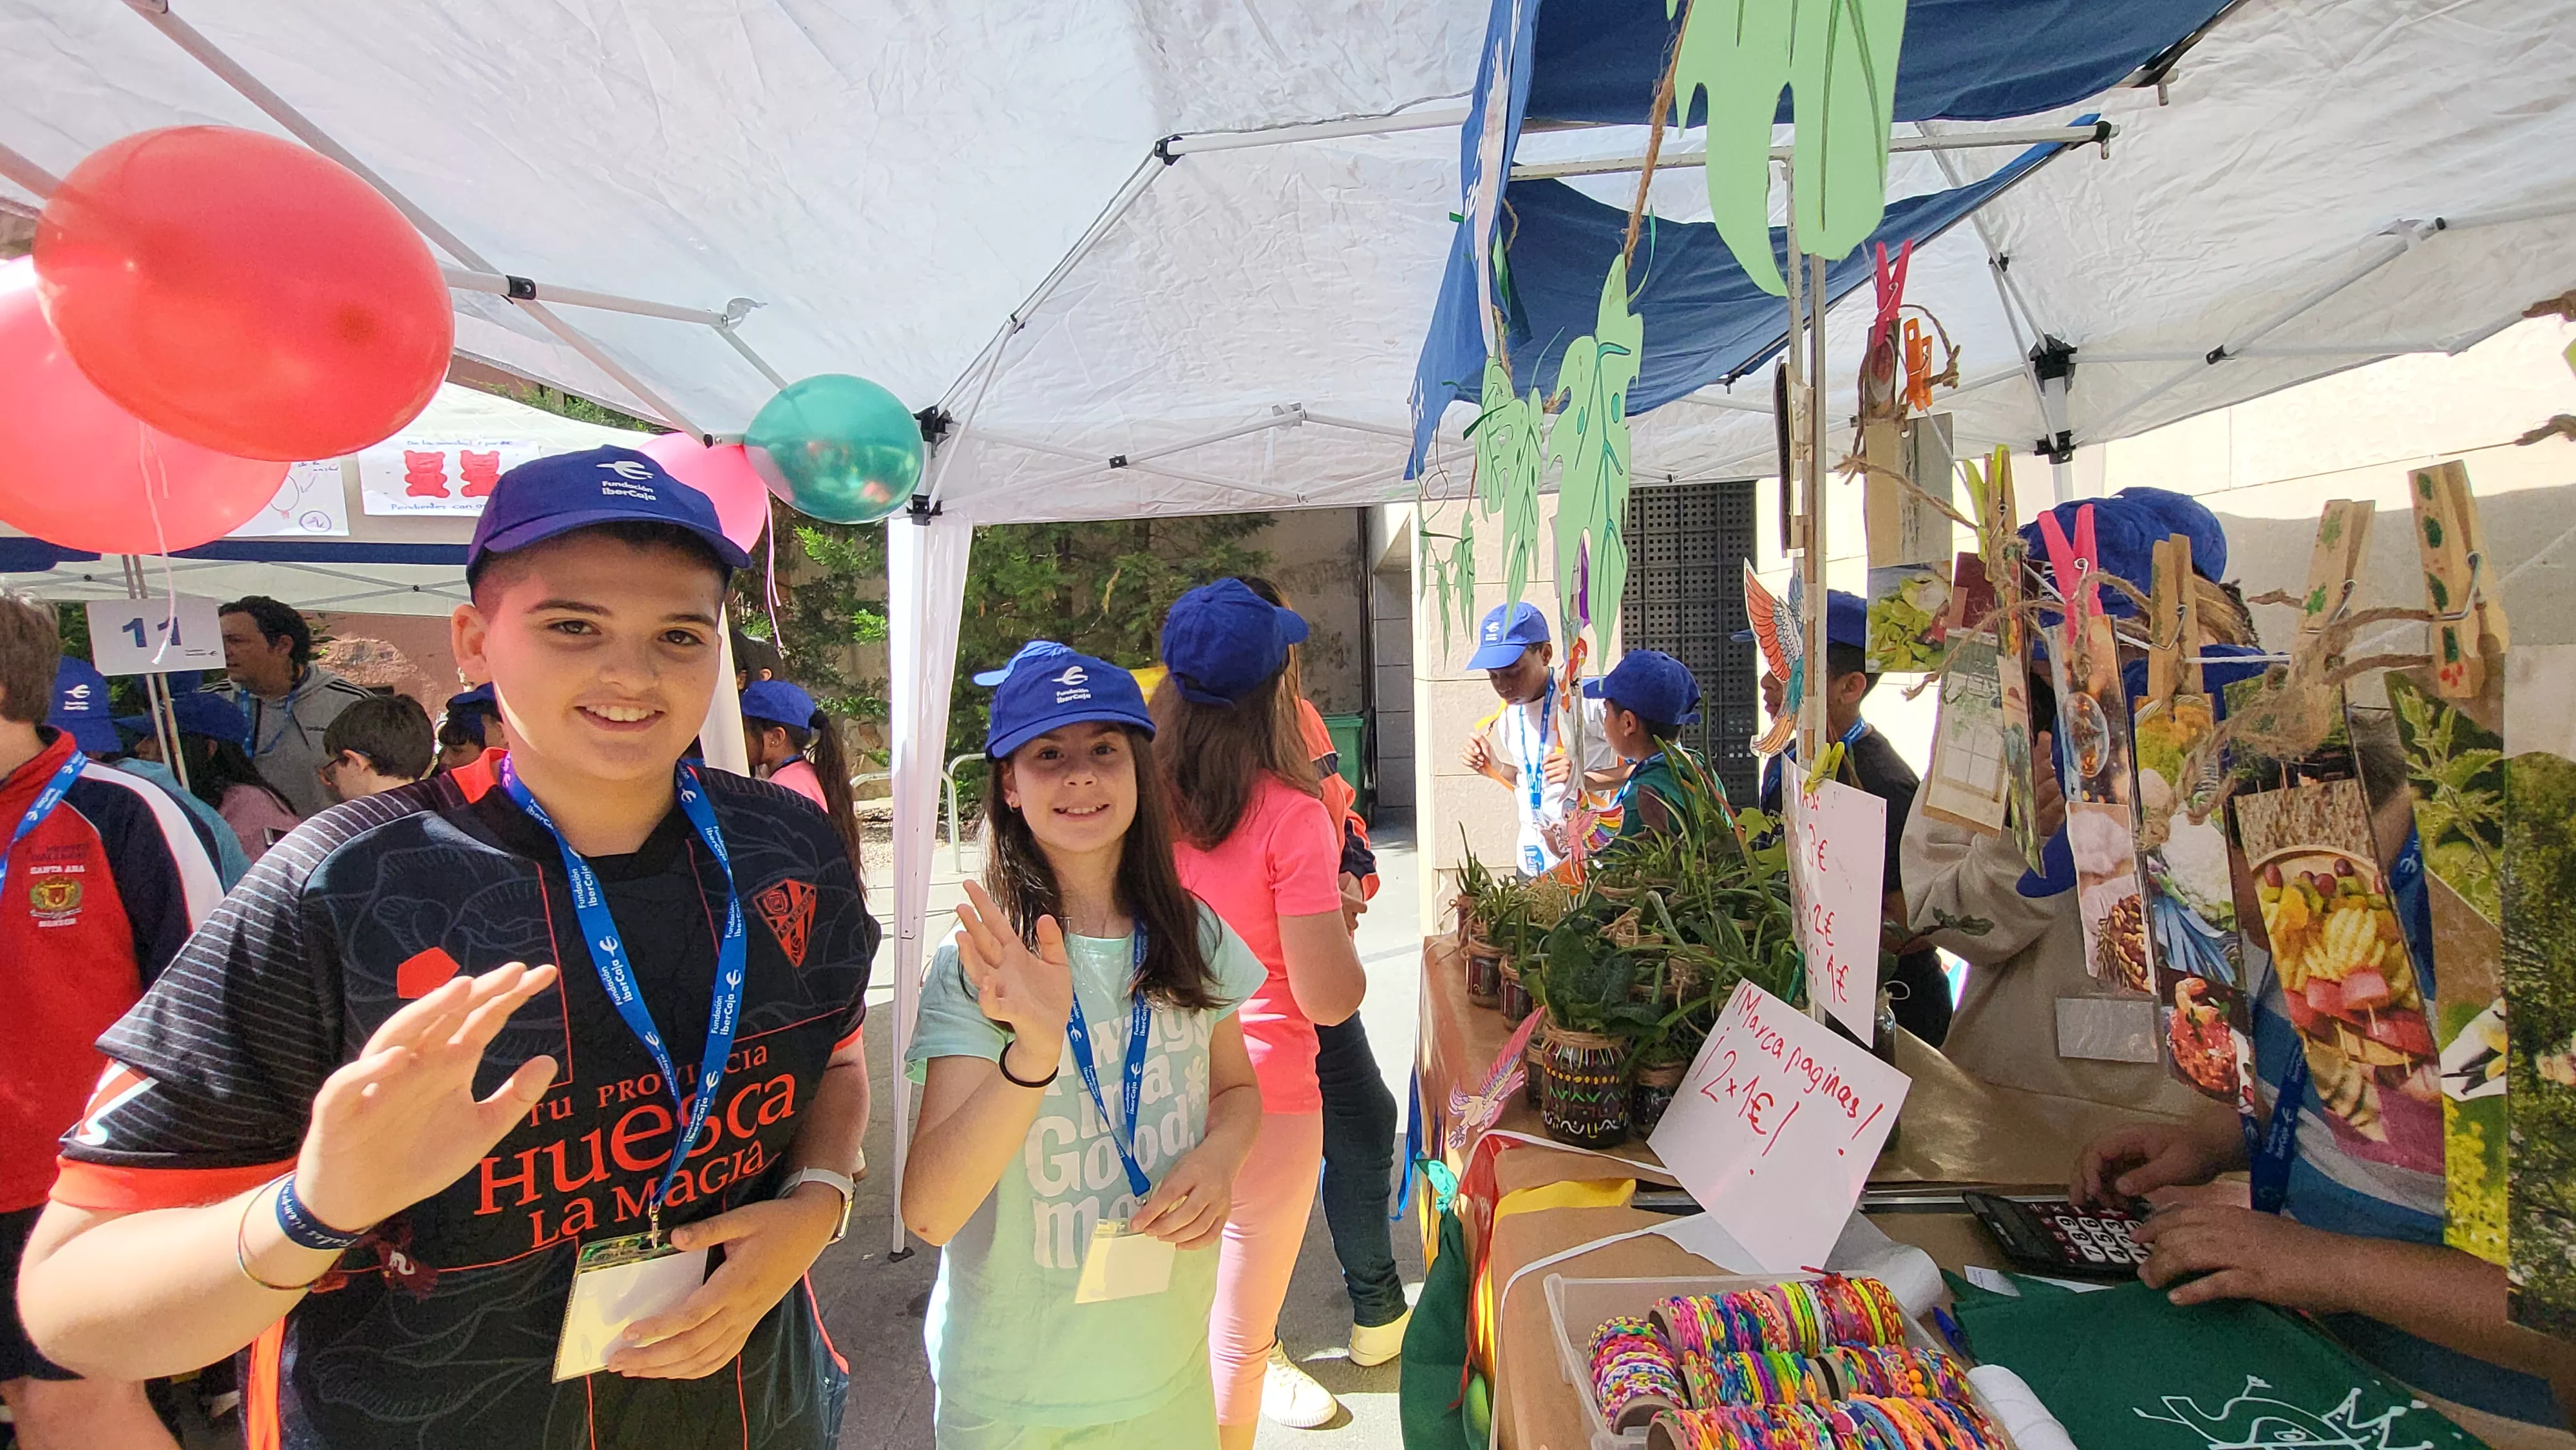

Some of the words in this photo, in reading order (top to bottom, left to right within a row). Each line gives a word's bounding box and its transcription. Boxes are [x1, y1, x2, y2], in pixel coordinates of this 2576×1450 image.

[601, 480, 653, 493] Fundación
[122, 616, 182, 648] 11
[571, 868, 587, 909] Fundación
[1813, 903, 1835, 947] 2€
[601, 966, 623, 1006] Fundación
[1826, 954, 1850, 1003] 1€
[711, 995, 723, 1035] Fundación
[528, 1196, 599, 1248] La
